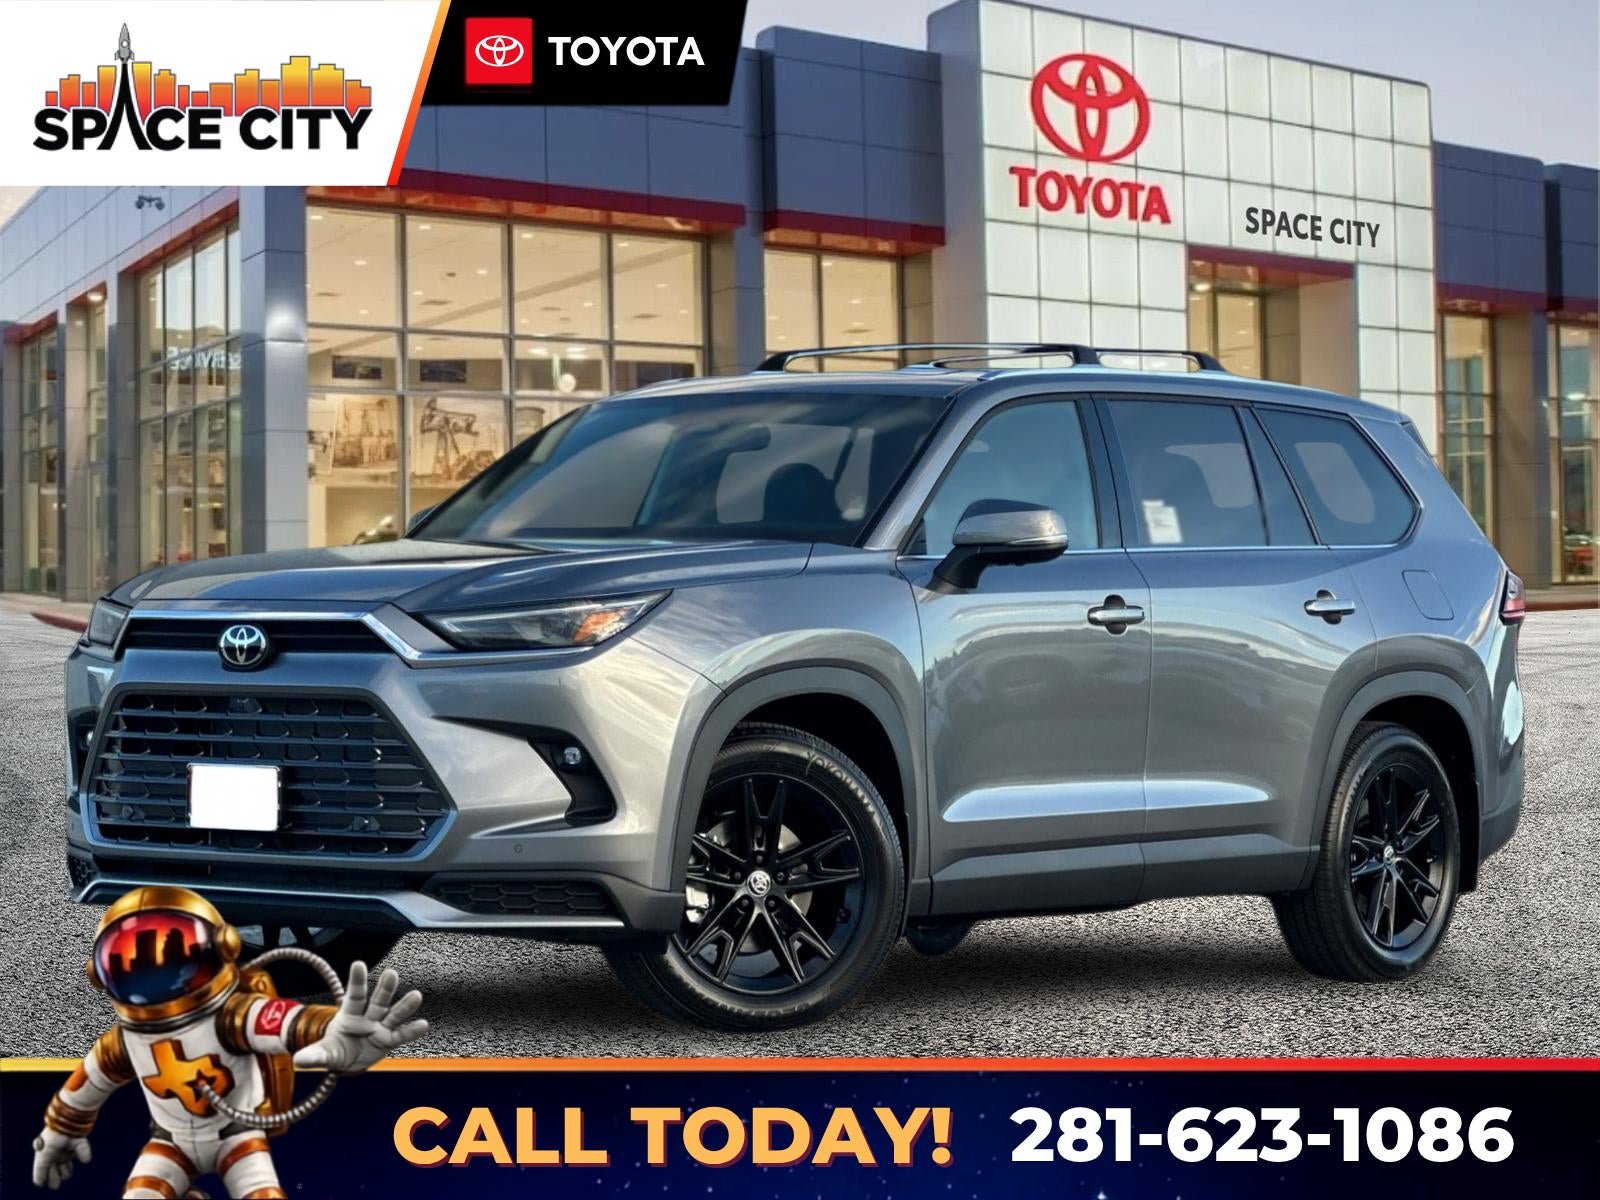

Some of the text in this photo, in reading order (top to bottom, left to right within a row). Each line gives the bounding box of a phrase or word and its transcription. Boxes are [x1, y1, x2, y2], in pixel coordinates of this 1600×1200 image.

[1009, 165, 1171, 225] TOYOTA
[1244, 206, 1381, 249] SPACE CITY
